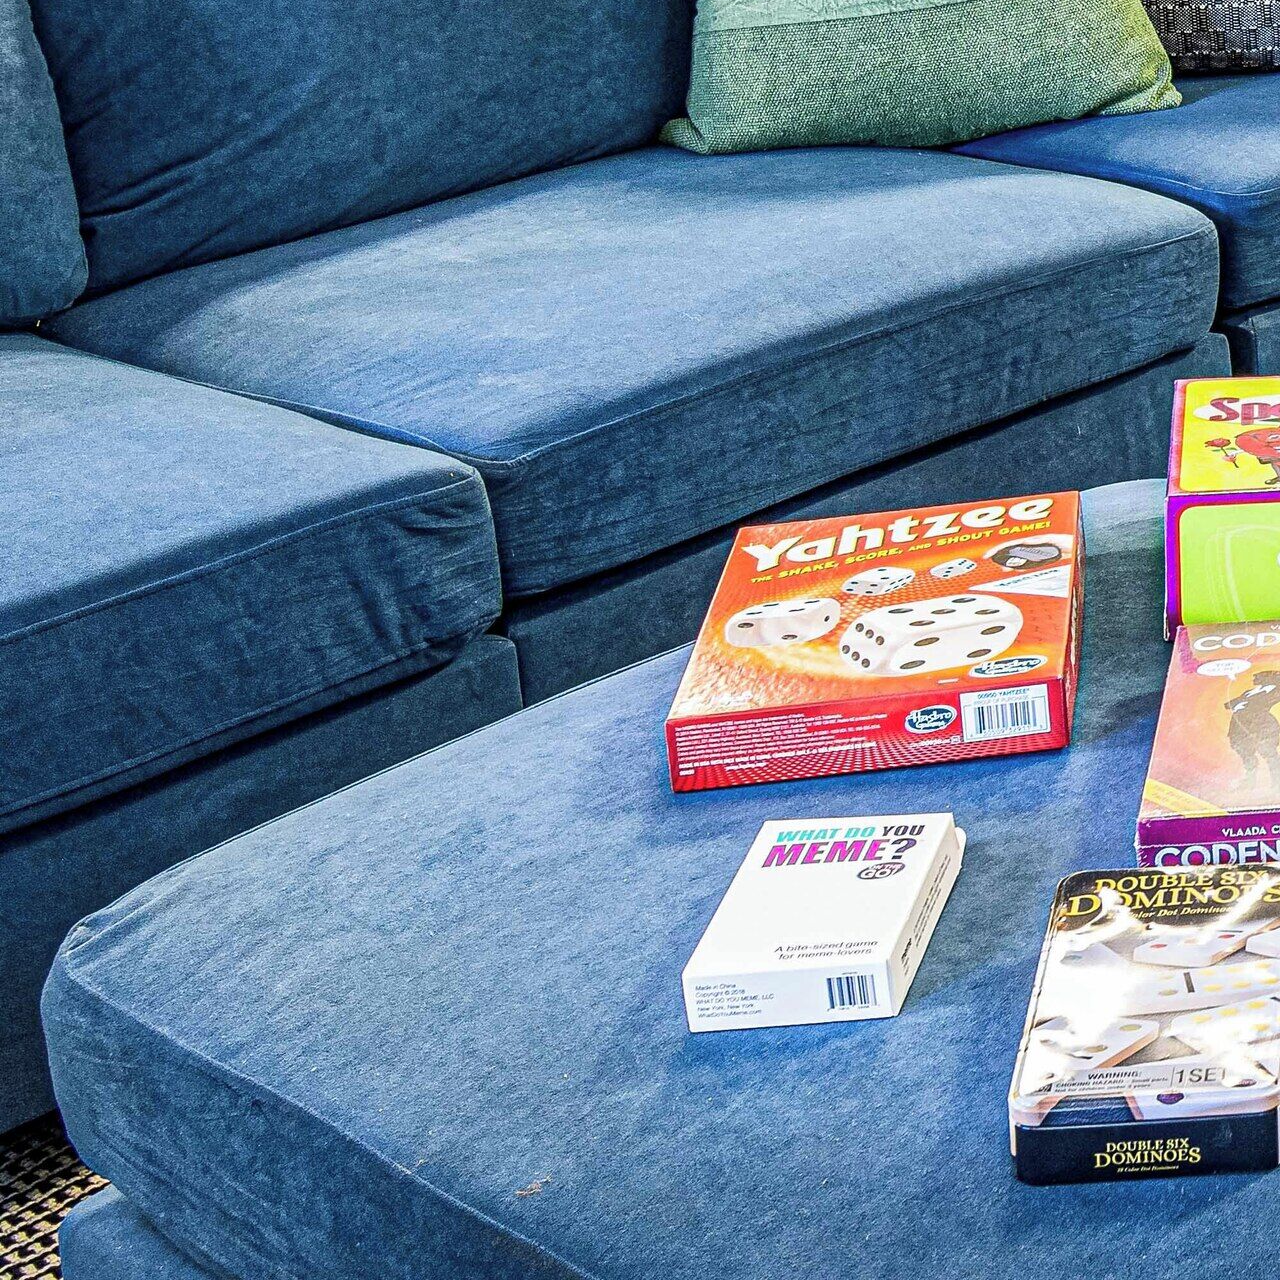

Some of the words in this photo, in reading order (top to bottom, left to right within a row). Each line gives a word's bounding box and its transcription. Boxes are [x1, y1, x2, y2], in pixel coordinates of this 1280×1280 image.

[741, 497, 1054, 571] Yahtzee
[750, 574, 773, 584] THE
[777, 560, 840, 580] SHAKE,
[845, 547, 903, 567] SCORE,
[908, 541, 933, 553] AND
[936, 530, 993, 548] SHOUT
[998, 520, 1051, 537] GAME!
[904, 710, 953, 724] Hasbro
[776, 828, 841, 843] WHAT
[842, 826, 876, 839] DO
[881, 824, 926, 837] YOU
[1221, 825, 1267, 838] VLAADA
[760, 837, 918, 869] MEME?
[1094, 872, 1214, 894] DOUBLE
[1156, 907, 1179, 918] Dot
[1106, 1139, 1165, 1154] DOUBLE
[1166, 1137, 1190, 1150] SIX
[1093, 1146, 1202, 1169] DOMINOES
